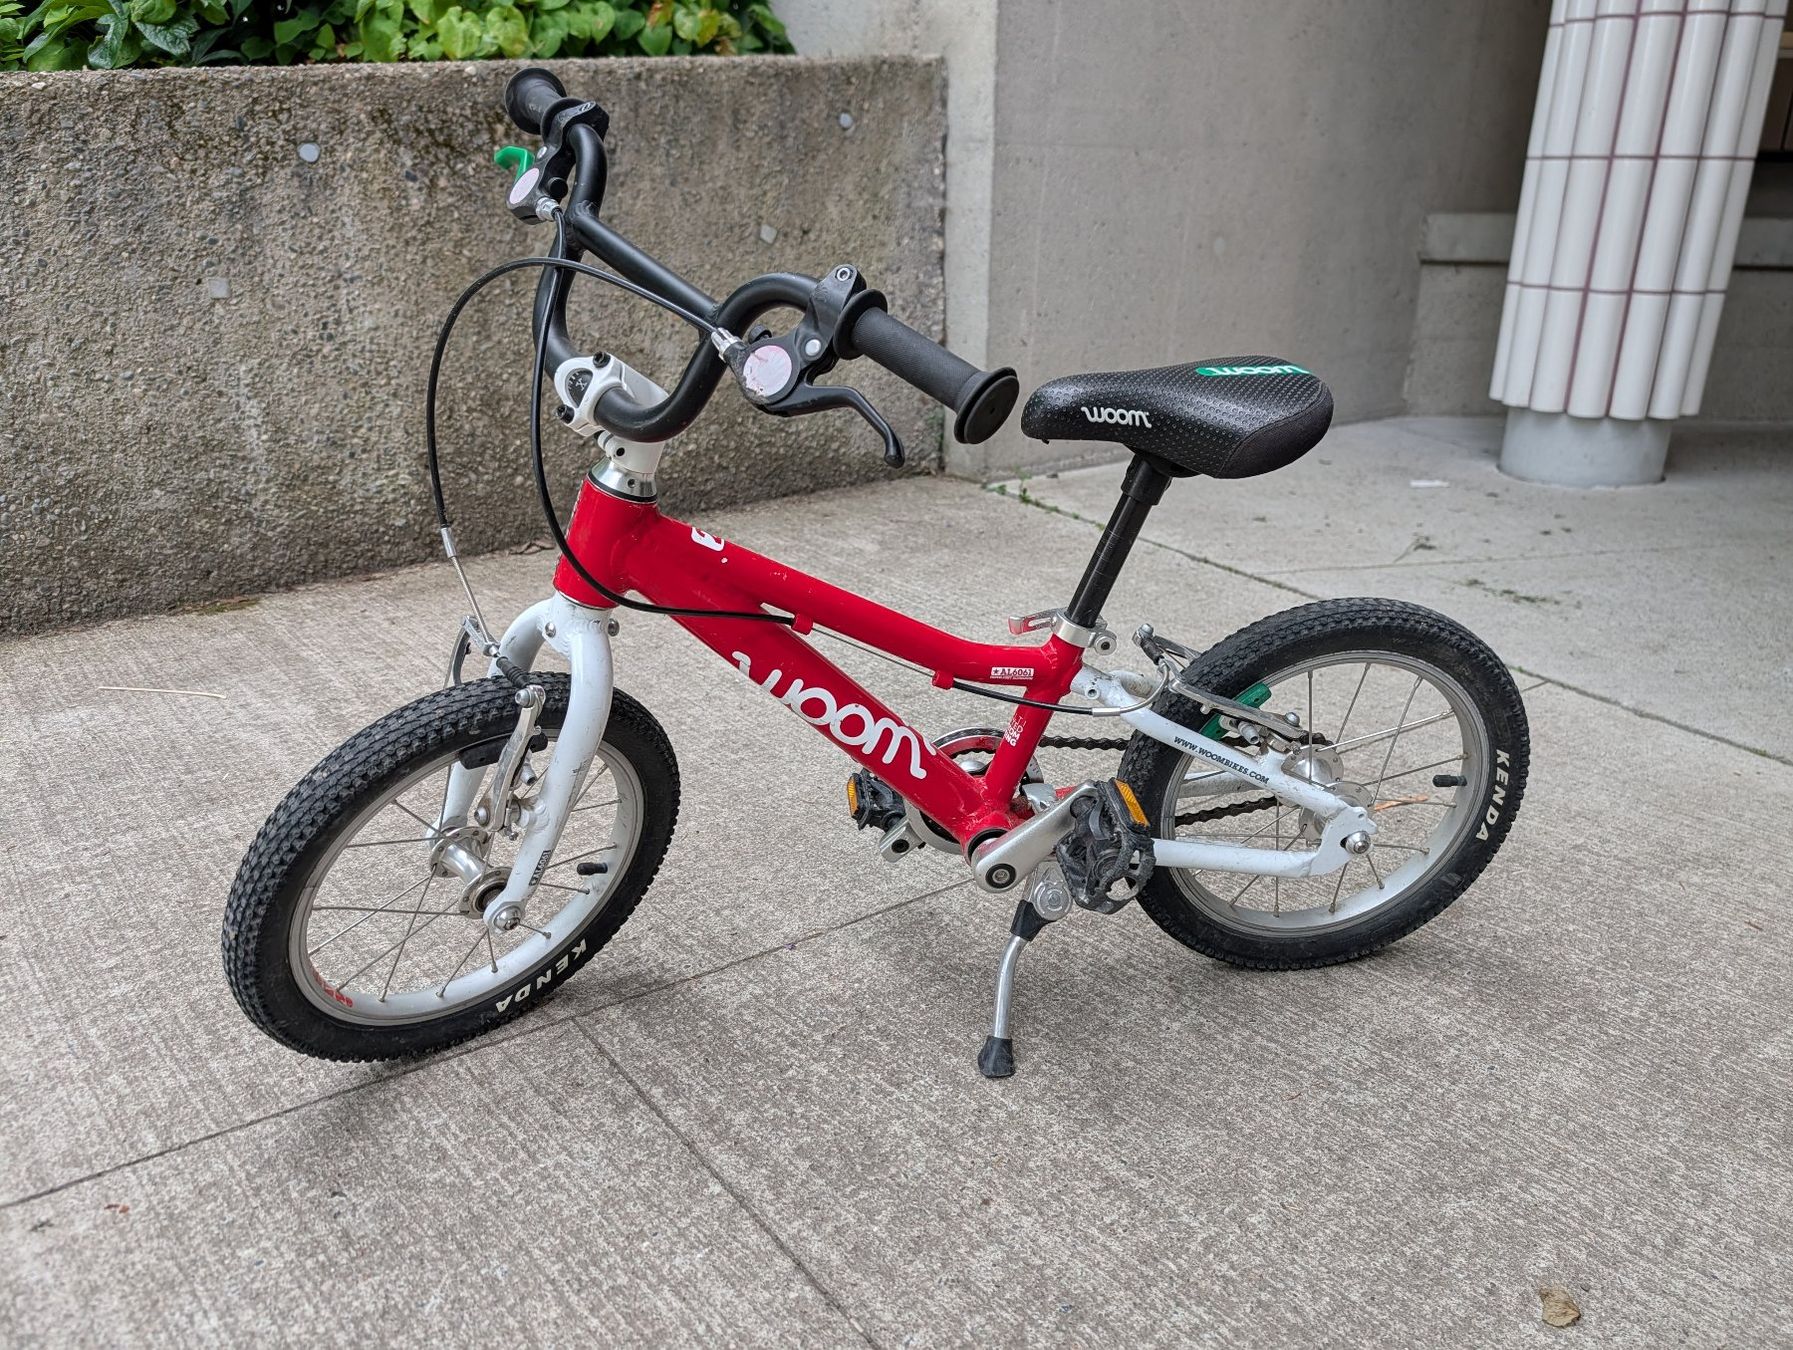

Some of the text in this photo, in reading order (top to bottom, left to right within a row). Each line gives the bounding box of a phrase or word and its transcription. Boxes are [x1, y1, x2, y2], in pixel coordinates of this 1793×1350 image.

[1081, 406, 1152, 428] woom
[1174, 736, 1269, 784] WWW.WOOMBIKES.COM
[1475, 749, 1510, 841] KENDA
[495, 938, 587, 1013] KENDA
